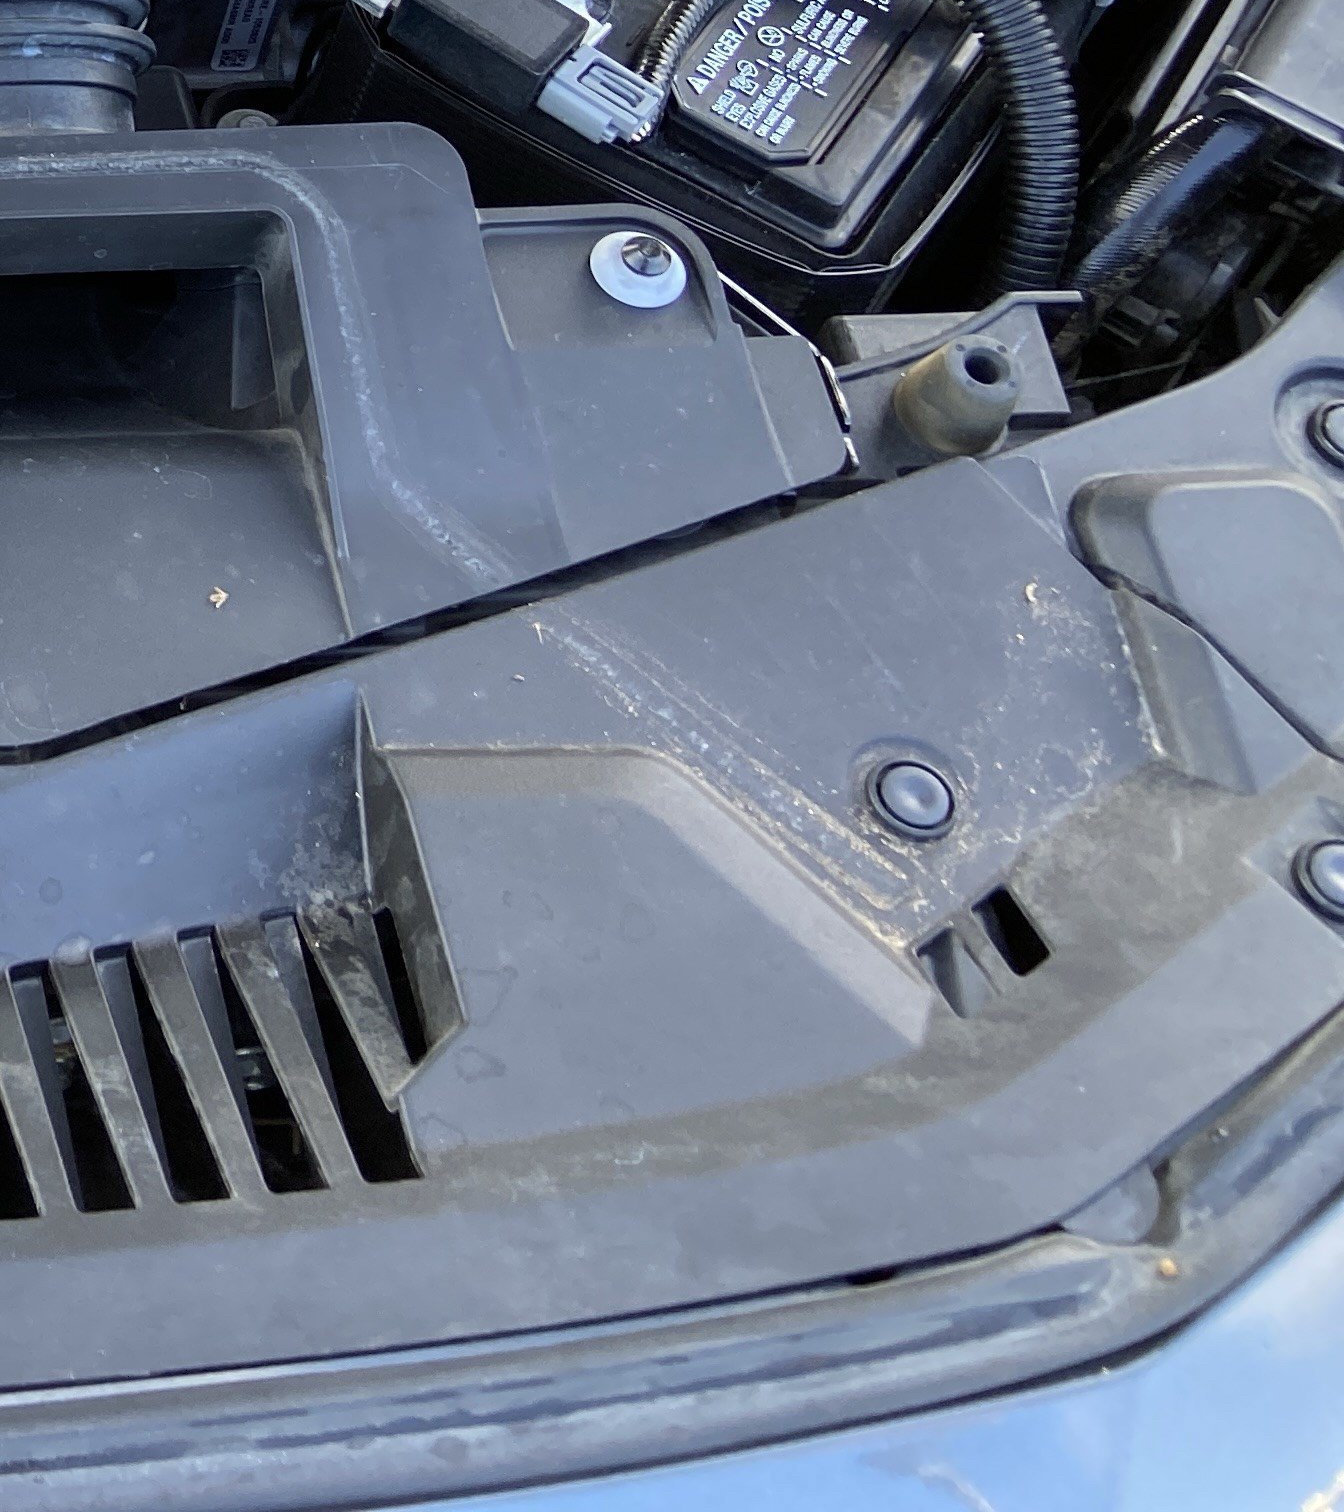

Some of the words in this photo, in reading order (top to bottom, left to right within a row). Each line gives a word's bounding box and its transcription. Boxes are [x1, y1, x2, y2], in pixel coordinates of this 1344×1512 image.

[791, 1, 822, 36] SULFURIC
[696, 29, 744, 82] DANGER
[769, 45, 786, 62] NO
[712, 89, 736, 114] SHIELD
[726, 103, 746, 122] EYES
